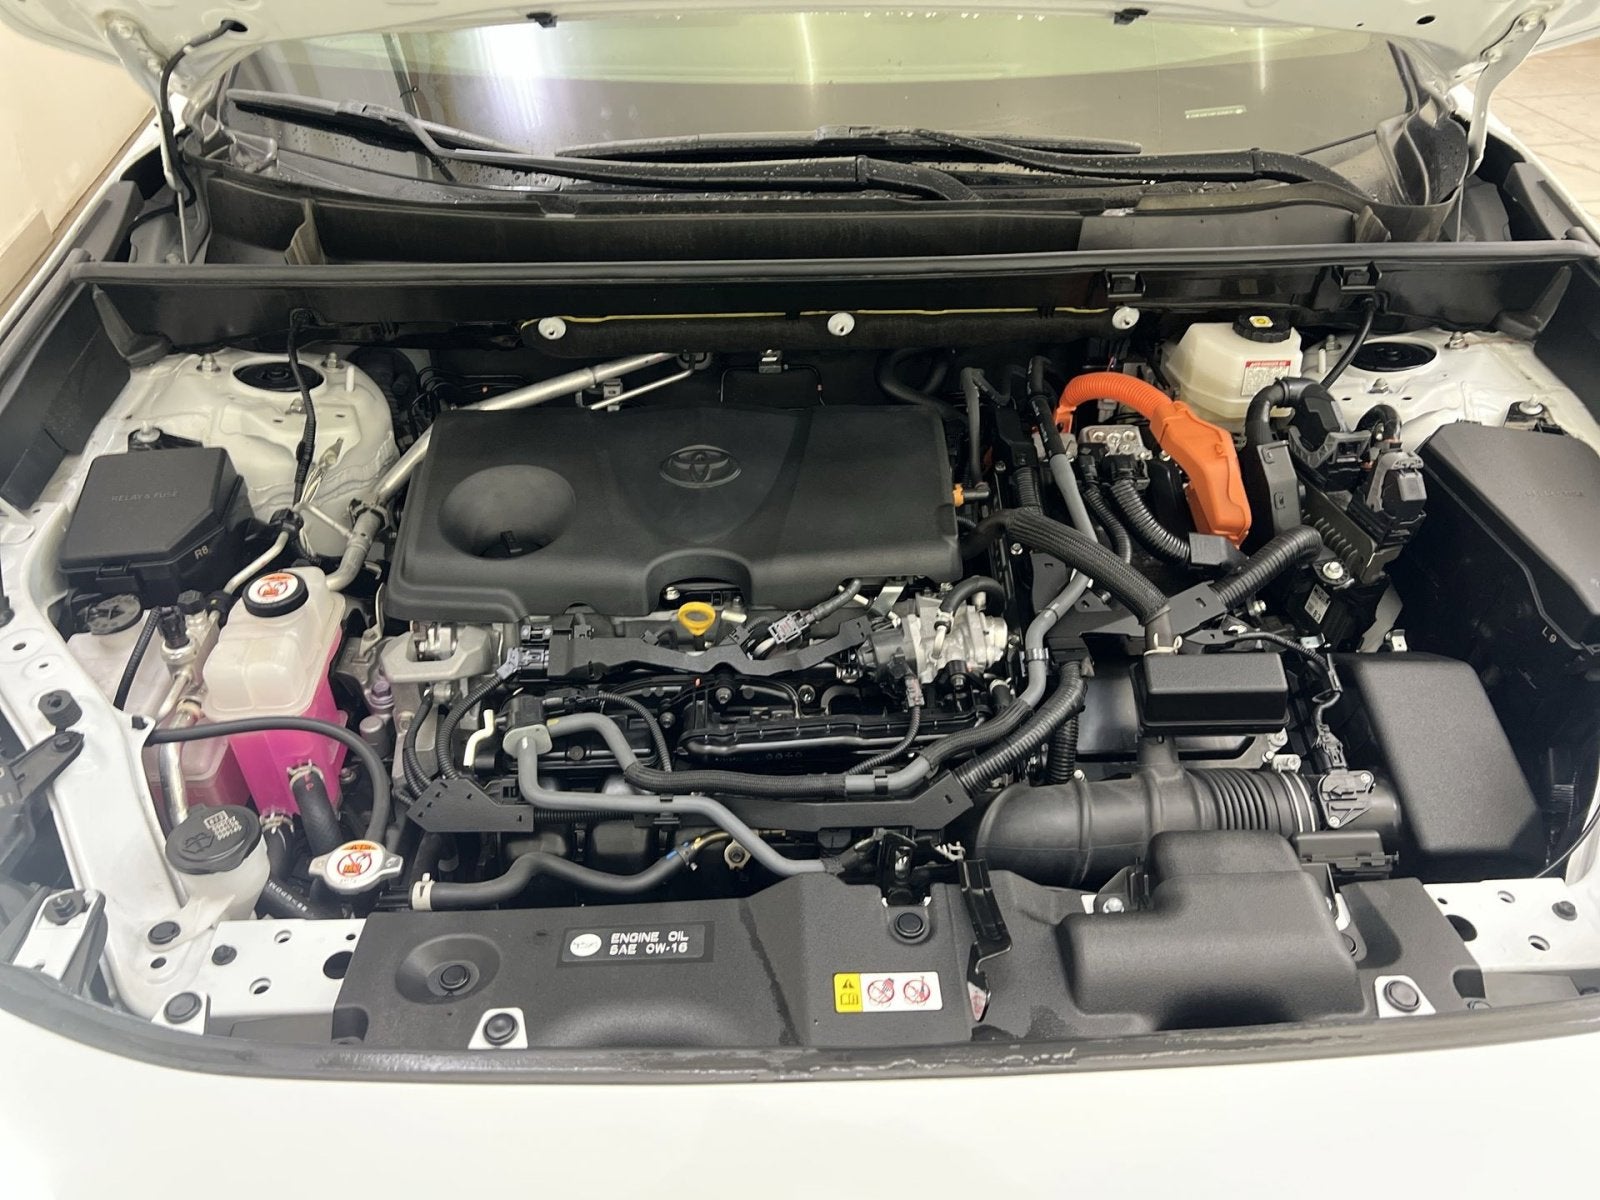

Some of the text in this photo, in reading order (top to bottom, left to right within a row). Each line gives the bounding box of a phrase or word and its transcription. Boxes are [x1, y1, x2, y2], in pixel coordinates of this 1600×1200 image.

[194, 545, 209, 560] R8
[610, 931, 690, 944] ENGINE OIL
[609, 944, 638, 955] SAE
[645, 942, 689, 954] 0W-16
